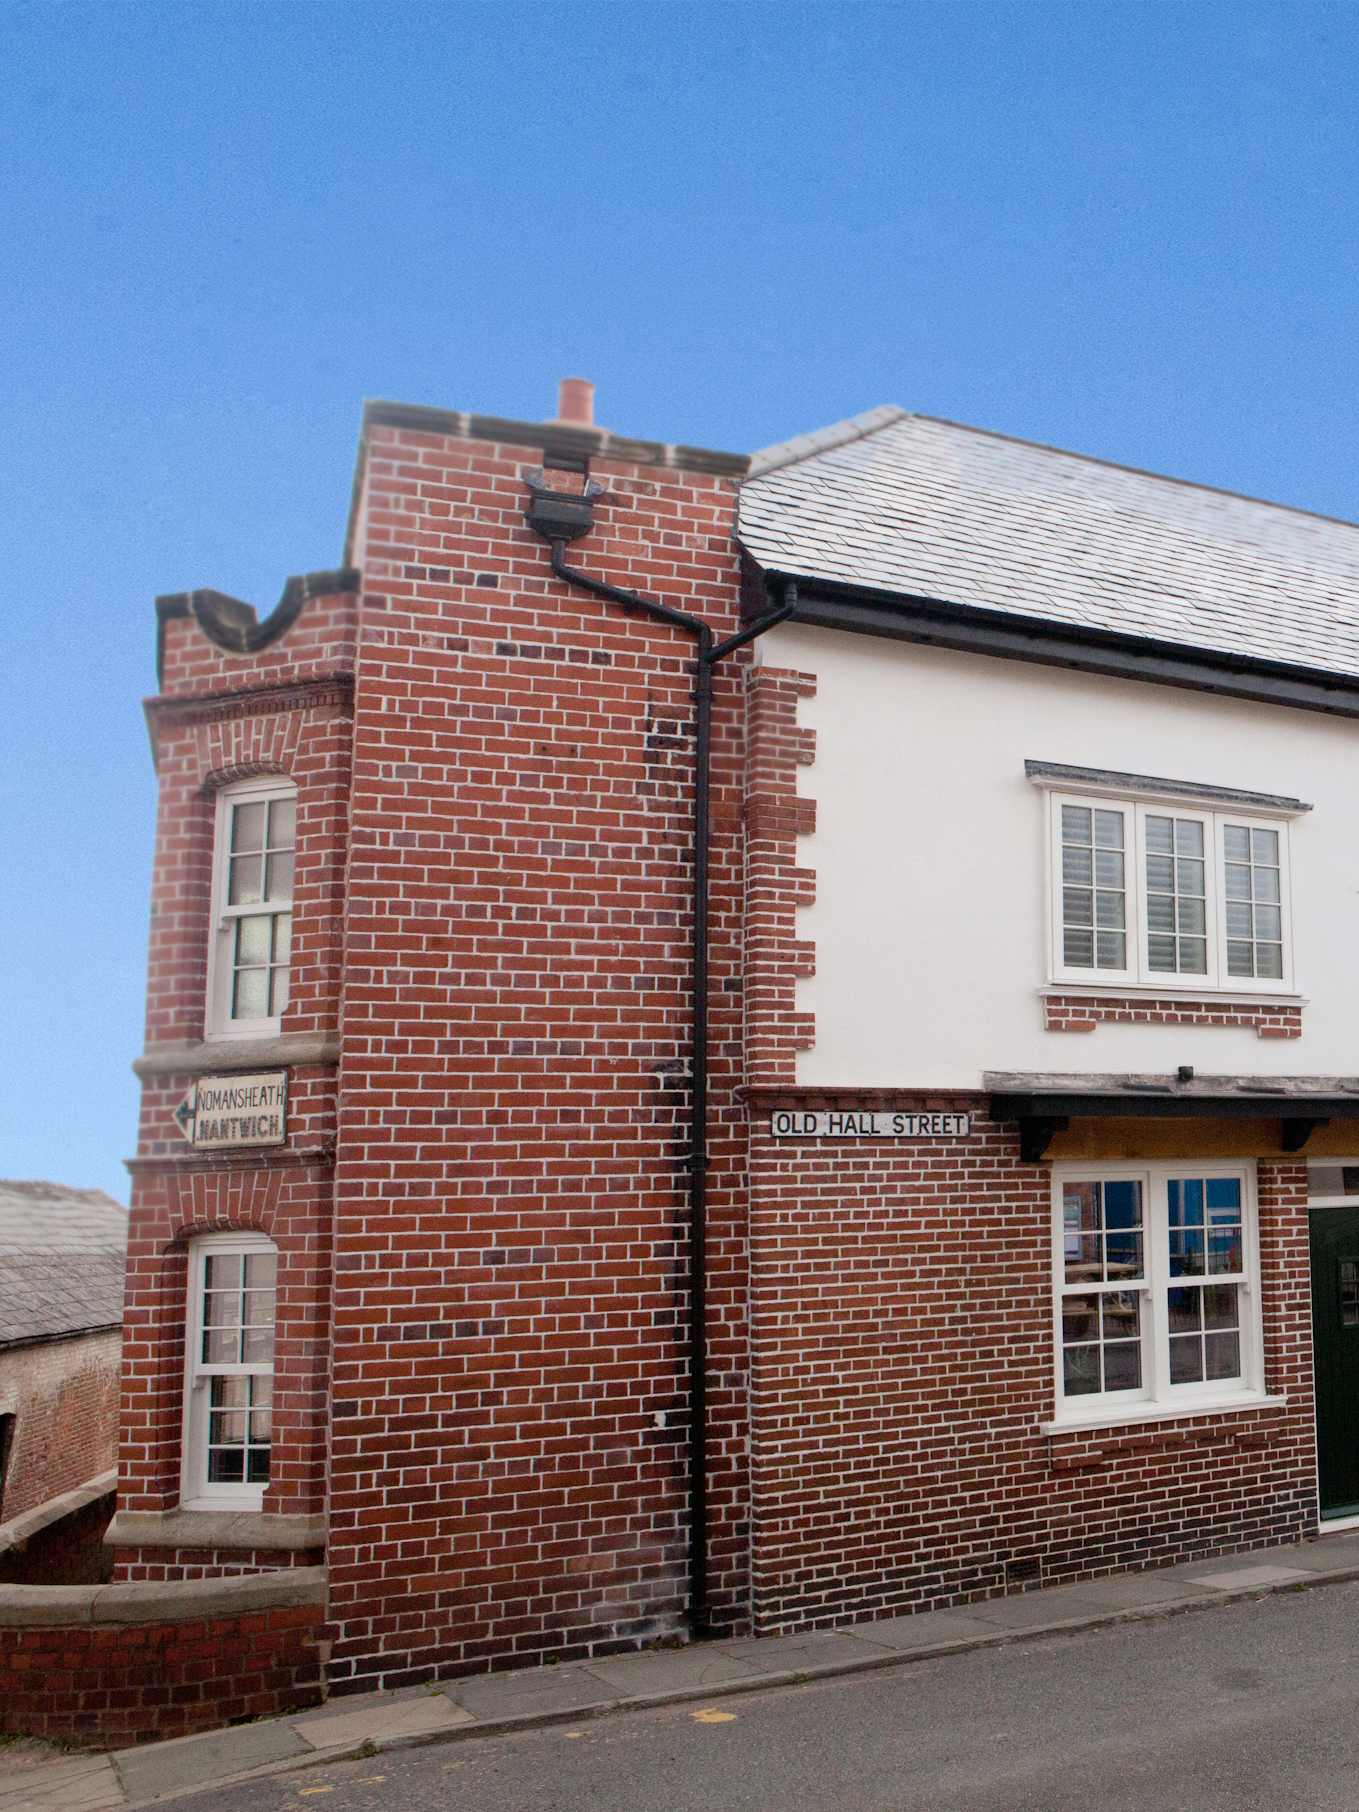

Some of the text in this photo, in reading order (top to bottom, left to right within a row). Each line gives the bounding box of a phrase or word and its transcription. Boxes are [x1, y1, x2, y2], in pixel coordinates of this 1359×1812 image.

[197, 1085, 284, 1111] NOMANSHEATH
[197, 1114, 279, 1141] NANTWICH
[776, 1113, 965, 1135] OLD HALL STREET
